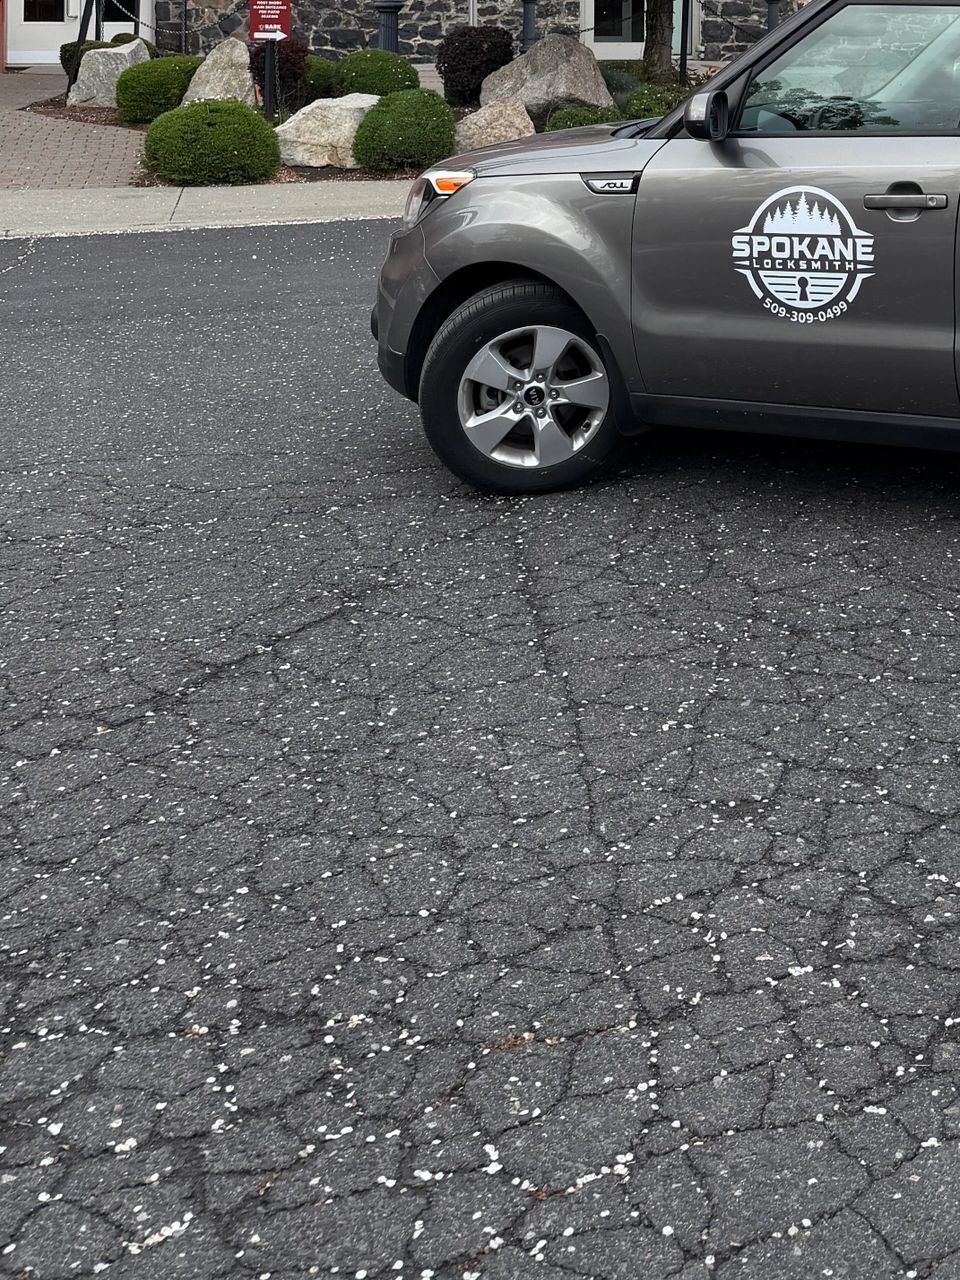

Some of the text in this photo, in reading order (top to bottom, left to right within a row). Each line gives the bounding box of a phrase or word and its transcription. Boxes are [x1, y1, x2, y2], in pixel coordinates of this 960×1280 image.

[731, 235, 875, 261] SPOKANE
[752, 258, 854, 271] LOCKSMITH
[762, 297, 848, 324] 509-309-0499
